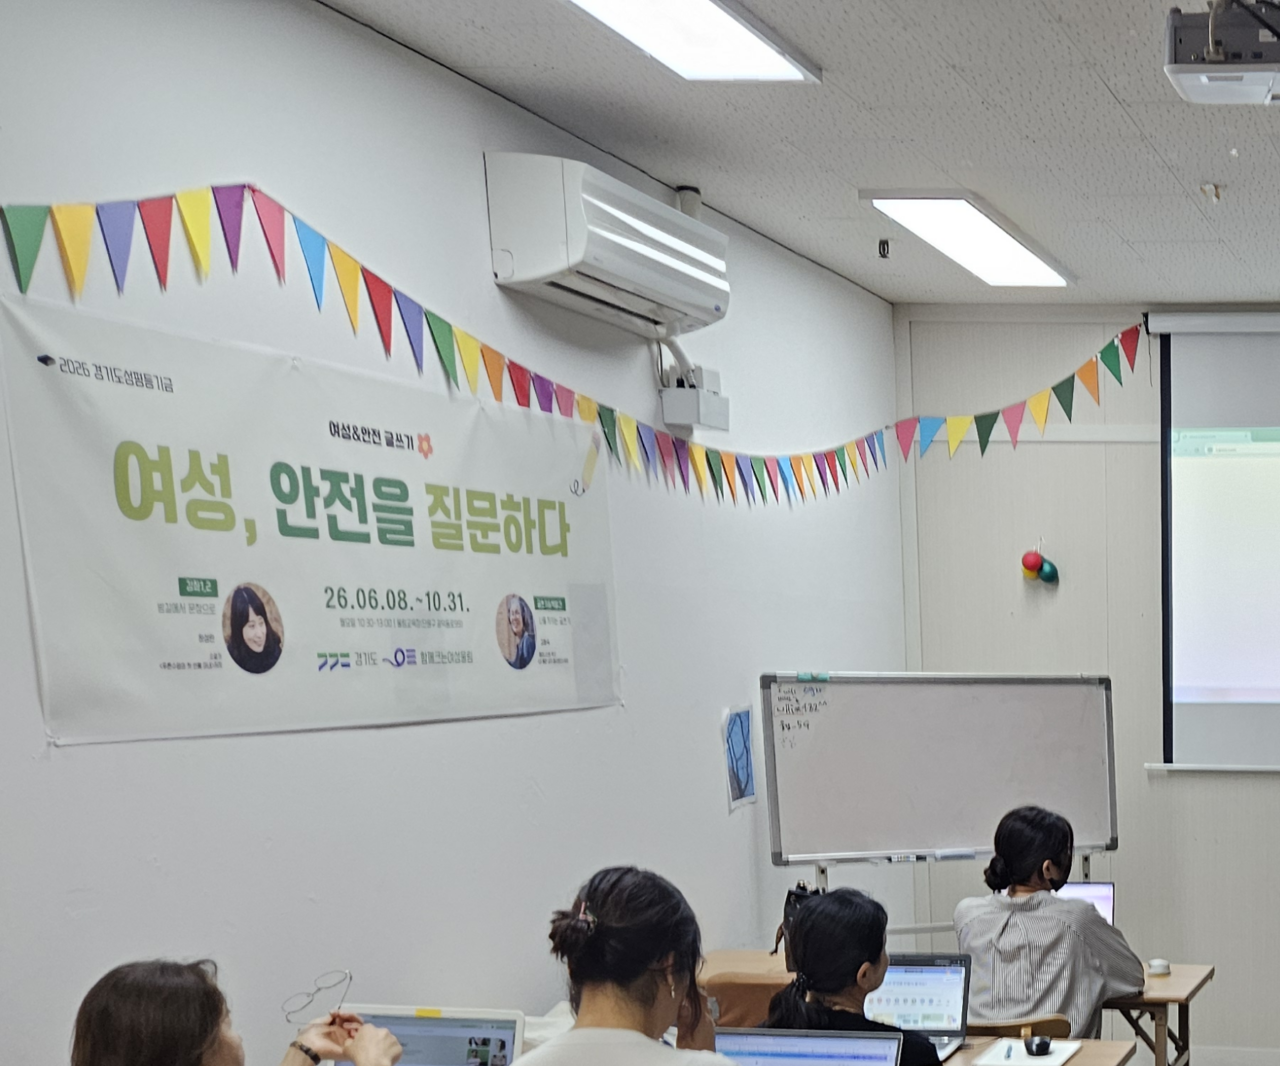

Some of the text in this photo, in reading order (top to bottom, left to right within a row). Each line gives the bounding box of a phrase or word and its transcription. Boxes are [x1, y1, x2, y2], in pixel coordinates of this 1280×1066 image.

[59, 357, 91, 378] 2026
[329, 420, 414, 451] 여성&안전 글쓰기
[113, 440, 571, 558] 여성, 안전을 질문하다
[355, 652, 379, 667] 경기도
